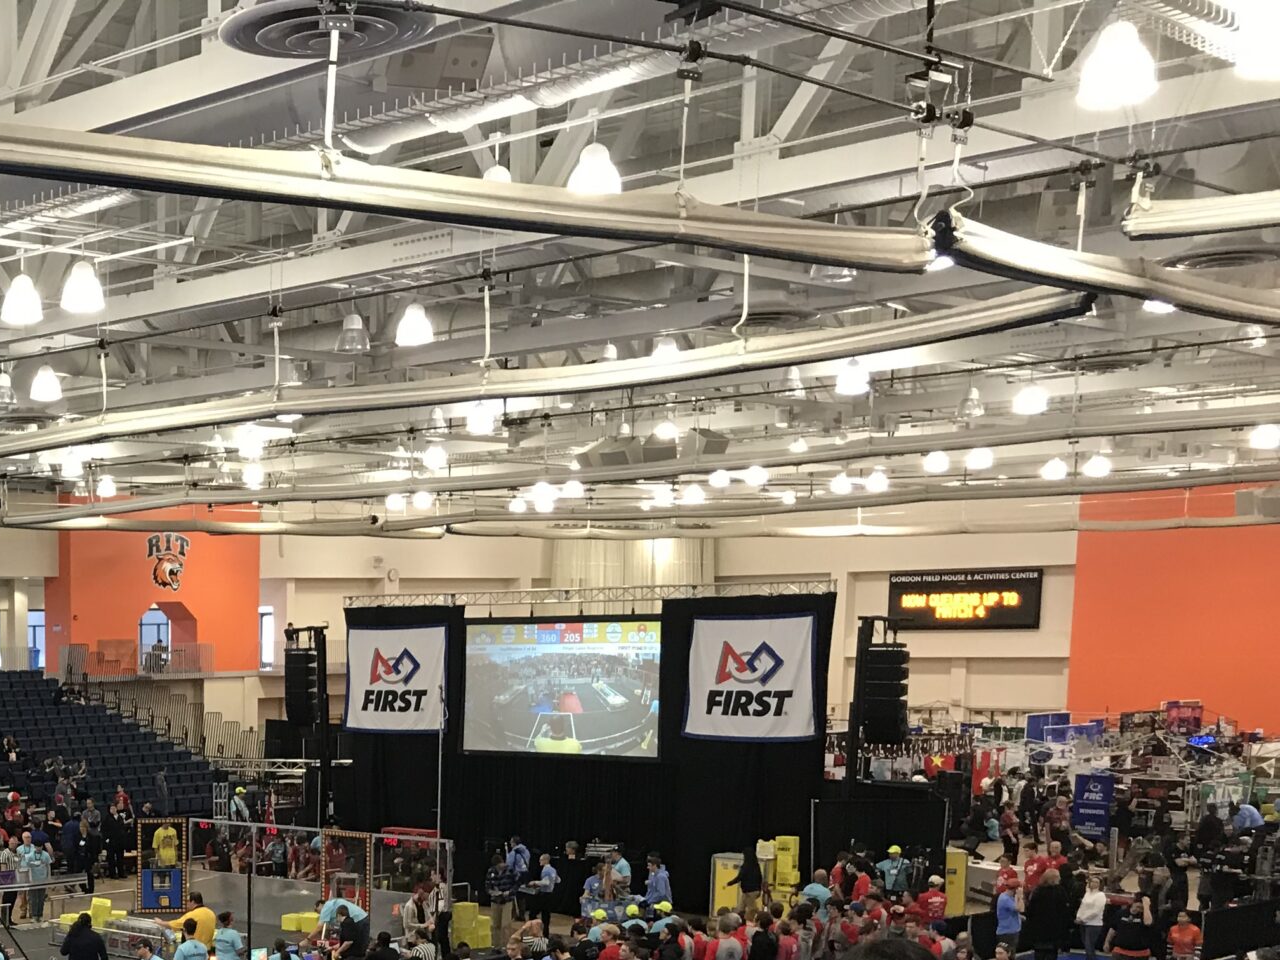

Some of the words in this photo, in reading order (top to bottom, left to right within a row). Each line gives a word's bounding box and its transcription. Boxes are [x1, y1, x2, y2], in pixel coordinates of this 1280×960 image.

[147, 532, 190, 560] RIT
[890, 575, 921, 583] GORDON
[901, 594, 927, 608] NOW
[982, 592, 1000, 606] UP
[1001, 591, 1019, 606] TO
[935, 605, 974, 619] MATCH
[975, 605, 986, 618] 4
[563, 633, 581, 642] 205
[361, 689, 428, 712] FIRST
[706, 689, 794, 717] FIRST
